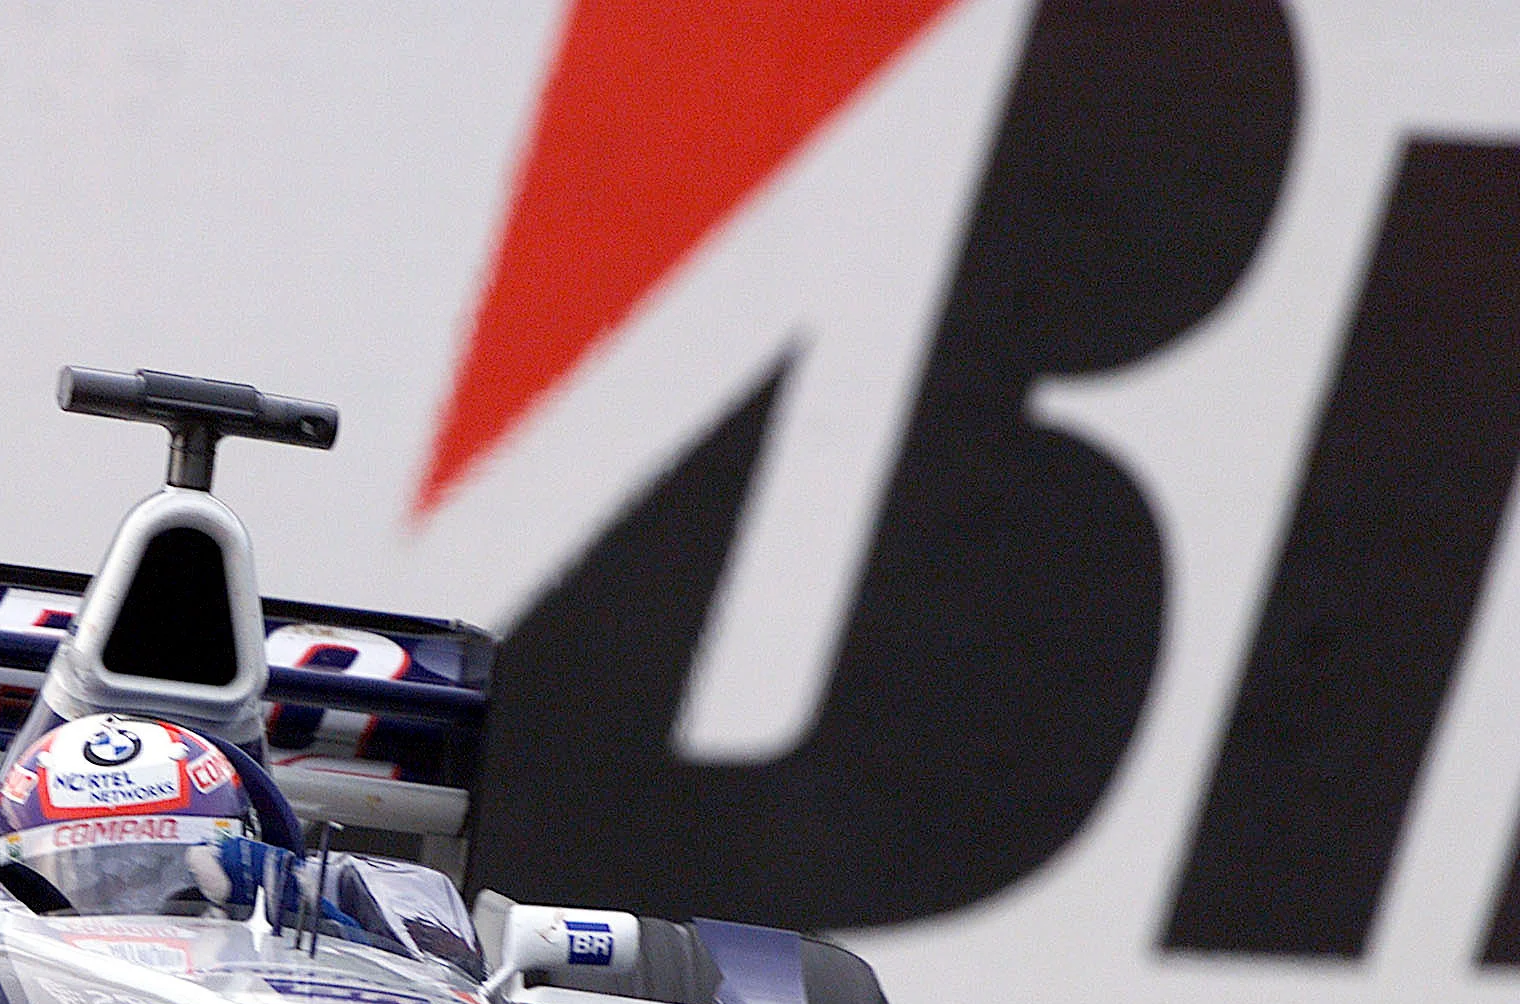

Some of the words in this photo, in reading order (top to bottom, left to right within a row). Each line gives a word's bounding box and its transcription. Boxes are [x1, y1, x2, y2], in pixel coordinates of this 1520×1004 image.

[54, 769, 135, 791] NORTEL
[90, 779, 176, 804] NETWORKS
[53, 819, 180, 847] COMPAQ
[572, 934, 610, 957] BR
